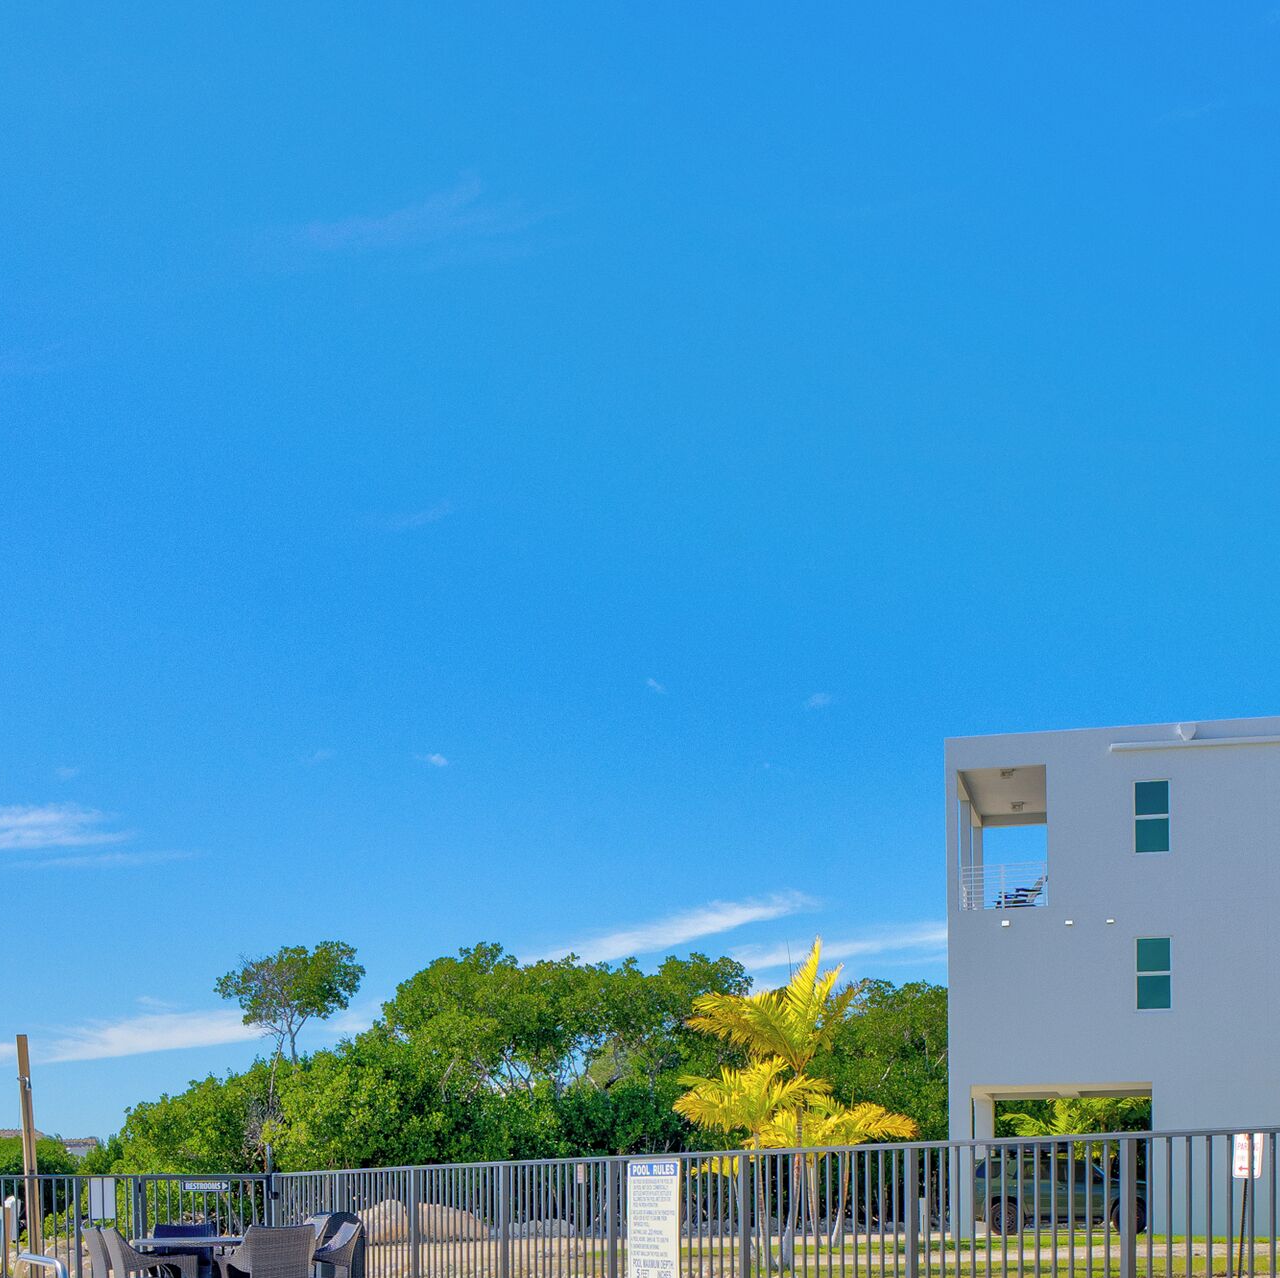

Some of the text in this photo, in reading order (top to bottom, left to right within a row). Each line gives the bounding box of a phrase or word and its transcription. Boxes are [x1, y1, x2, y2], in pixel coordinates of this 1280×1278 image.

[632, 1164, 675, 1176] POOL RULES
[185, 1182, 221, 1190] RESTROOMS
[636, 1269, 641, 1278] 5
